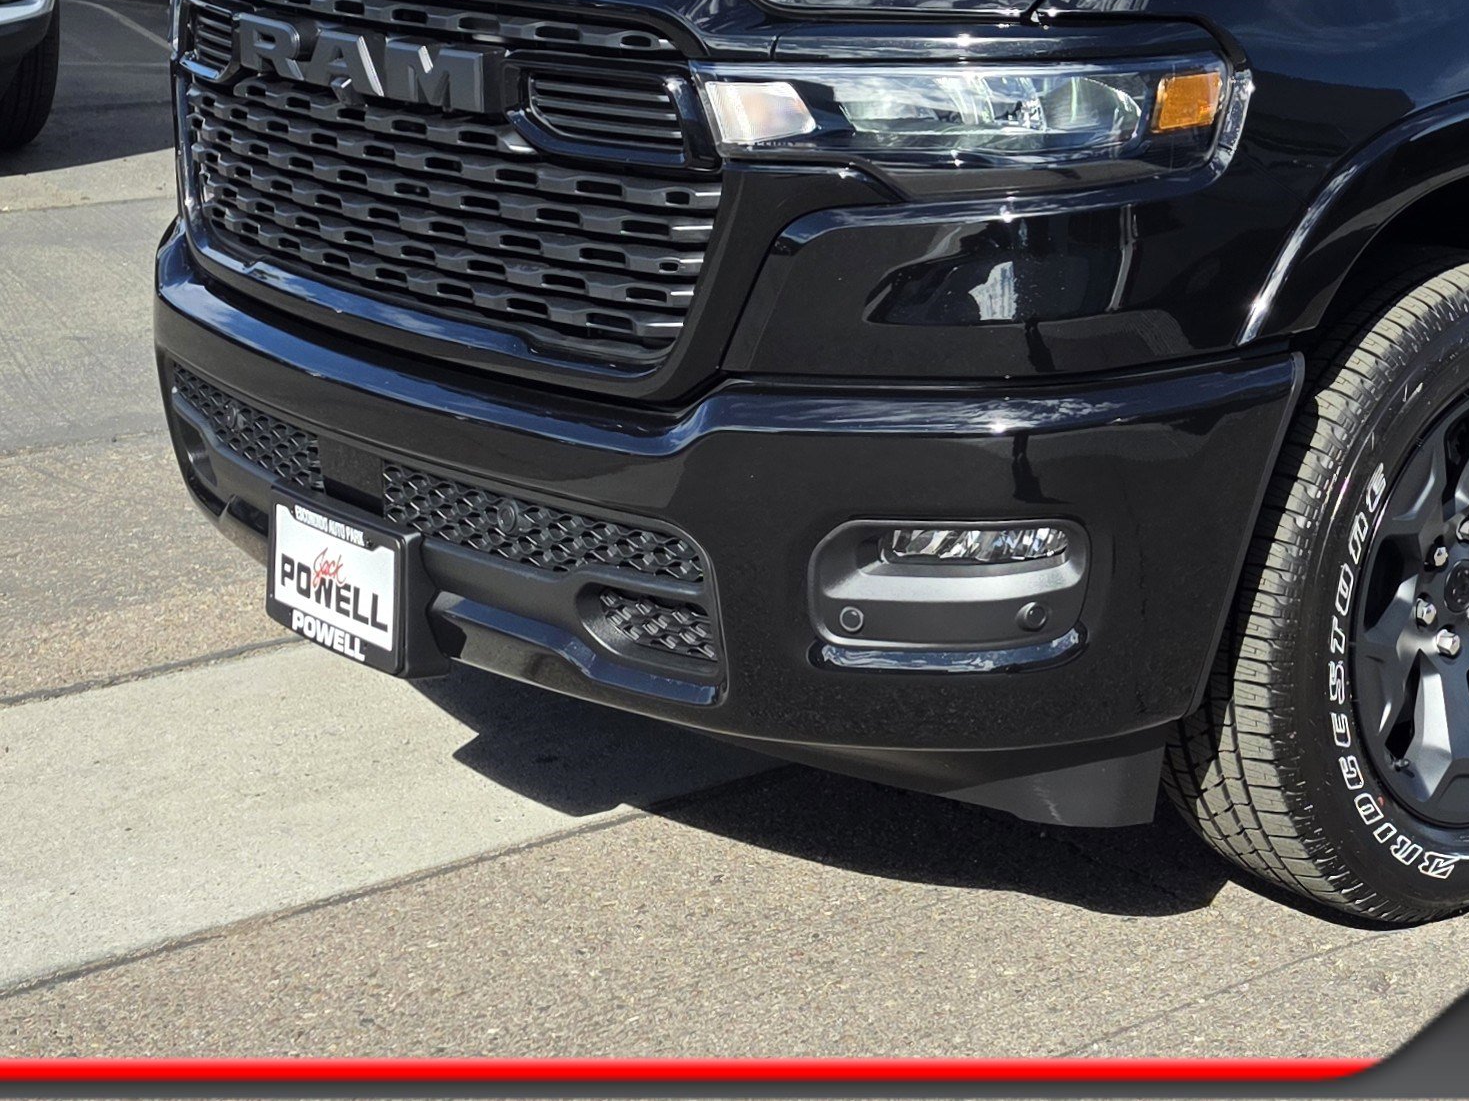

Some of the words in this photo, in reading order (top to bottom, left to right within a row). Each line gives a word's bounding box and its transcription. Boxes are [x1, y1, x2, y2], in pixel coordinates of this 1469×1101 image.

[238, 12, 497, 115] RAM
[281, 552, 389, 633] POWELL
[312, 546, 348, 588] Jack
[291, 608, 366, 662] POWELL
[1328, 461, 1462, 881] BRIDGESTONE
